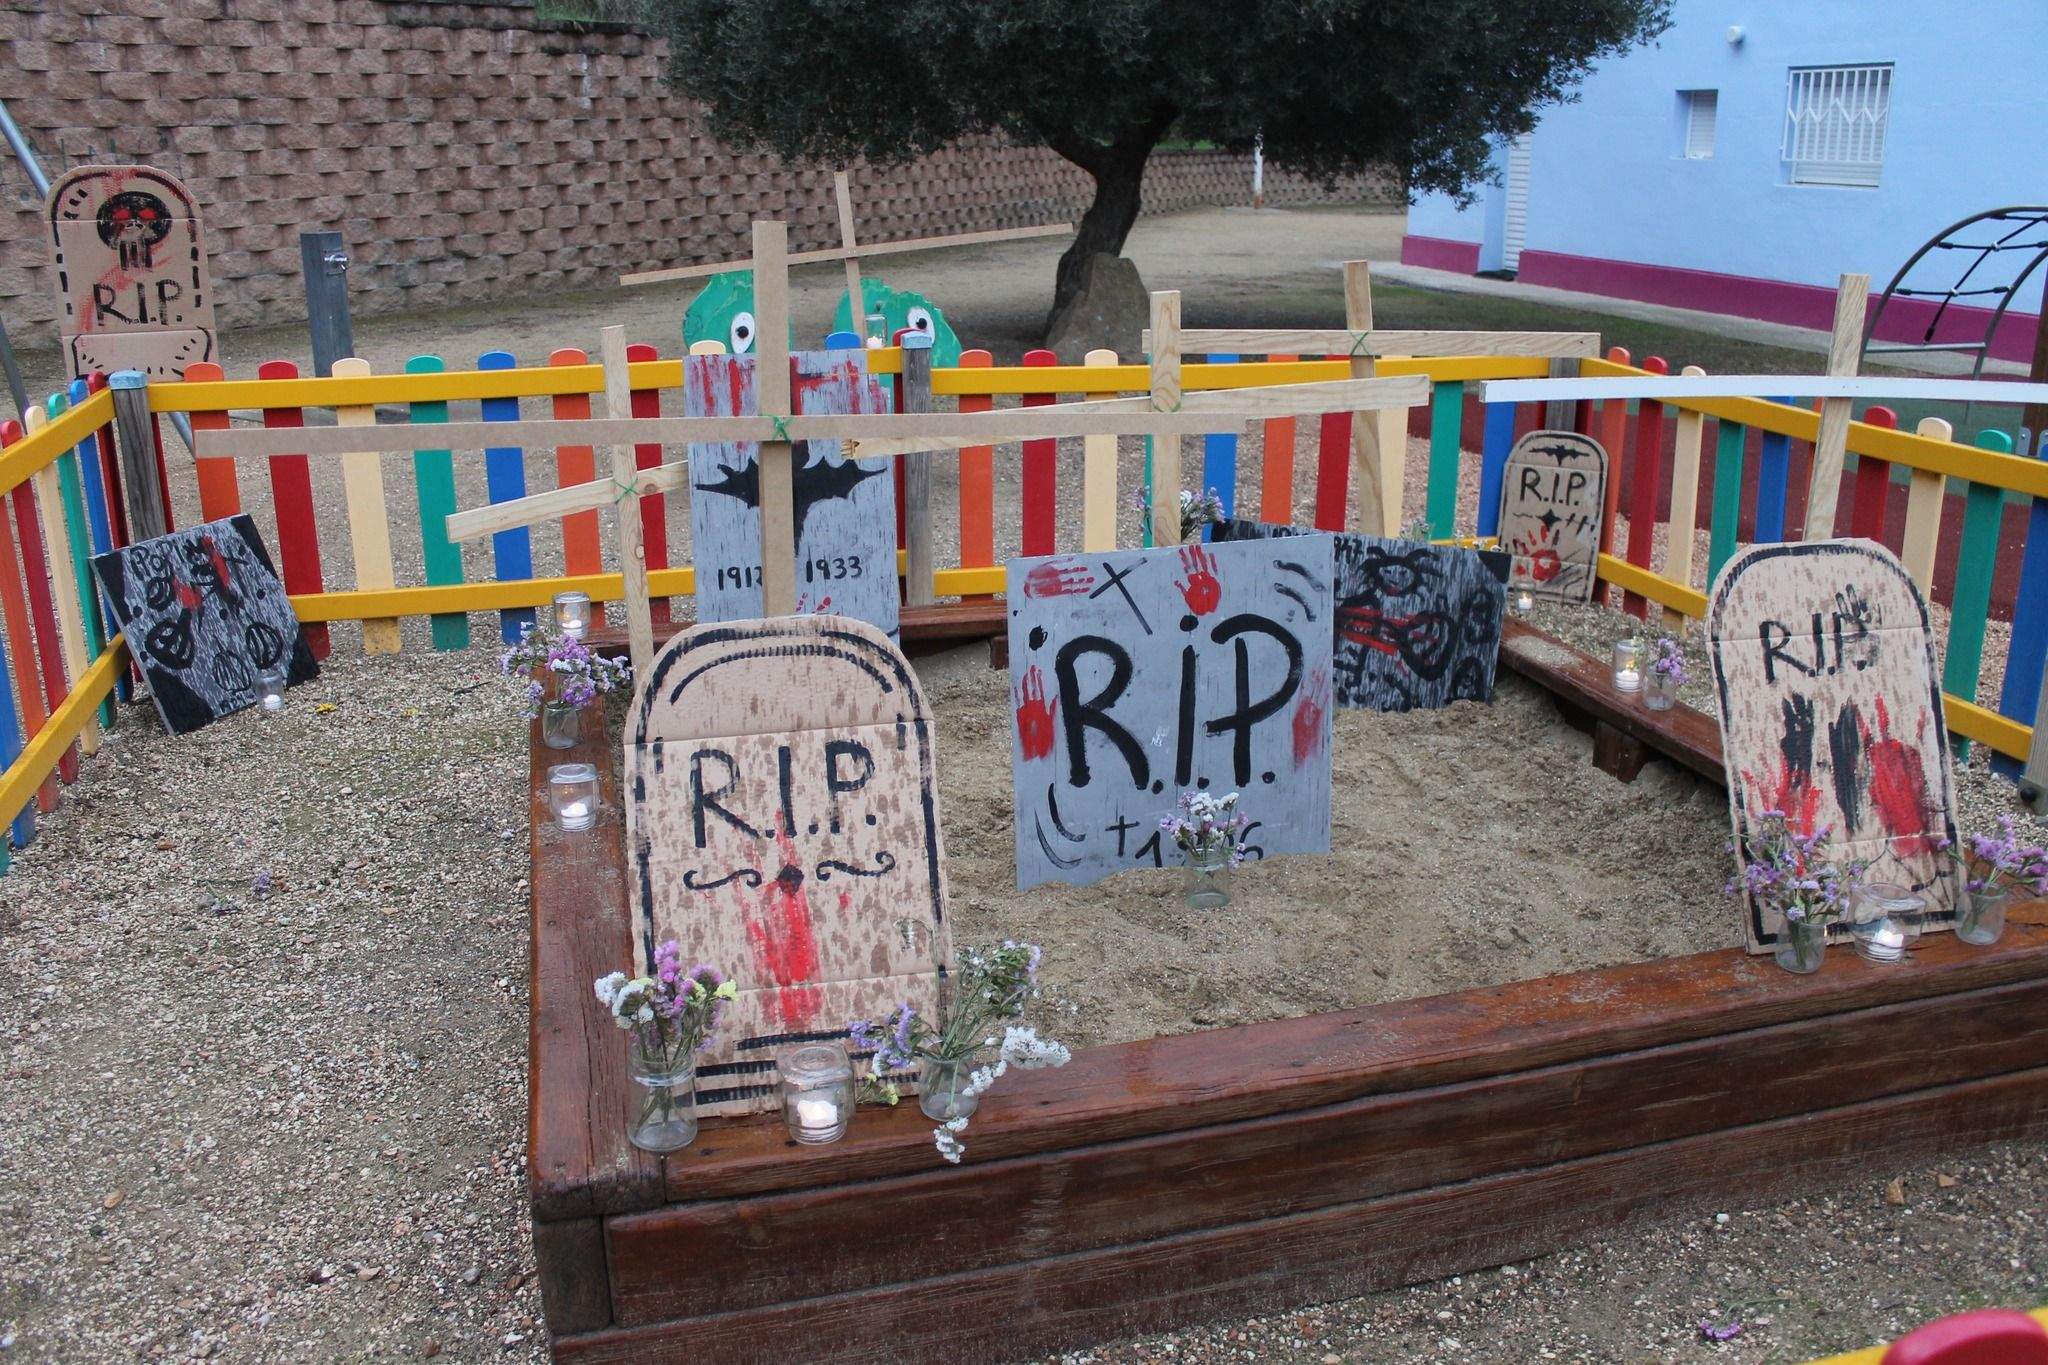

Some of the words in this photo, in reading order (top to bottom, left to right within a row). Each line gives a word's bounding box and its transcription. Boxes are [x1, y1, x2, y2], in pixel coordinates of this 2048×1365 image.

[1519, 467, 1587, 506] R.I.P.
[805, 555, 863, 583] 1933
[689, 739, 877, 849] R.I.P.
